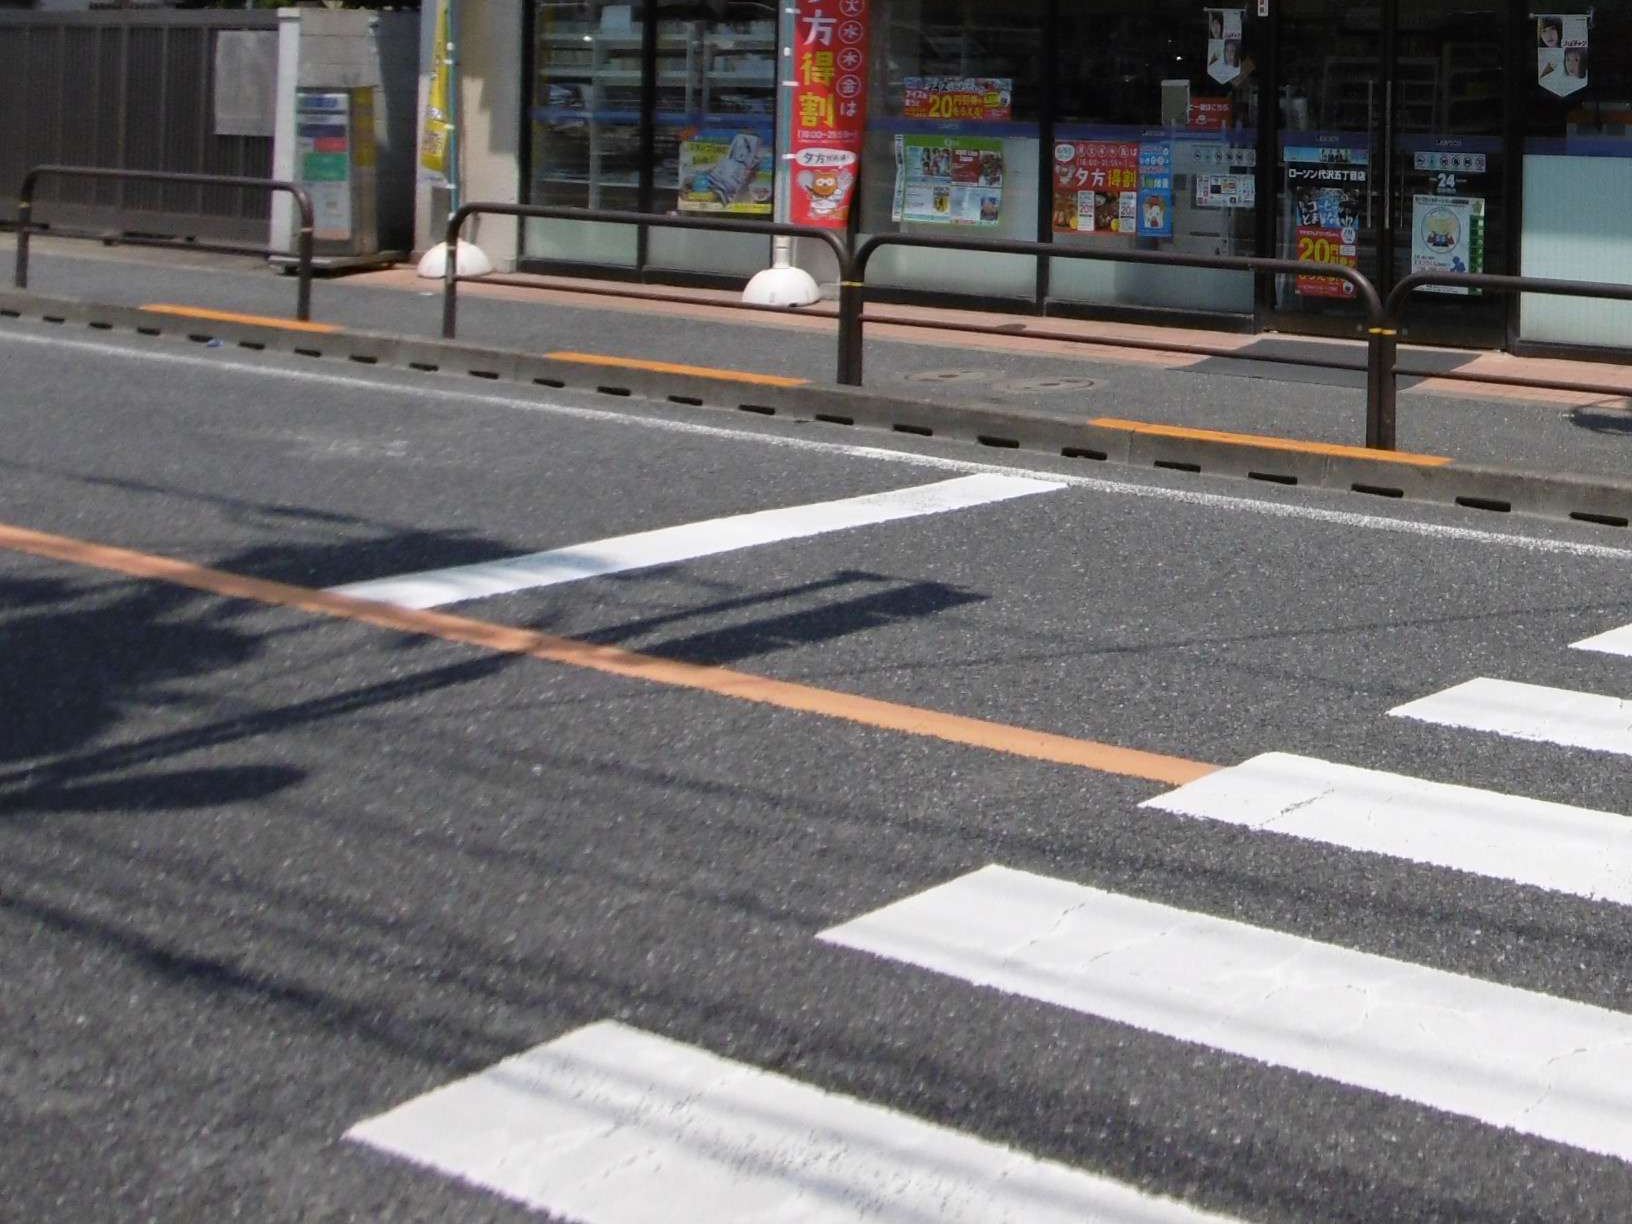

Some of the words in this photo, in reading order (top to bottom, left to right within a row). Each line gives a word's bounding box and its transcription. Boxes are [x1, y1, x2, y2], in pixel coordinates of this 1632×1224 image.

[1288, 168, 1367, 182] ローソン代沢五丁目店
[1437, 172, 1456, 188] 24
